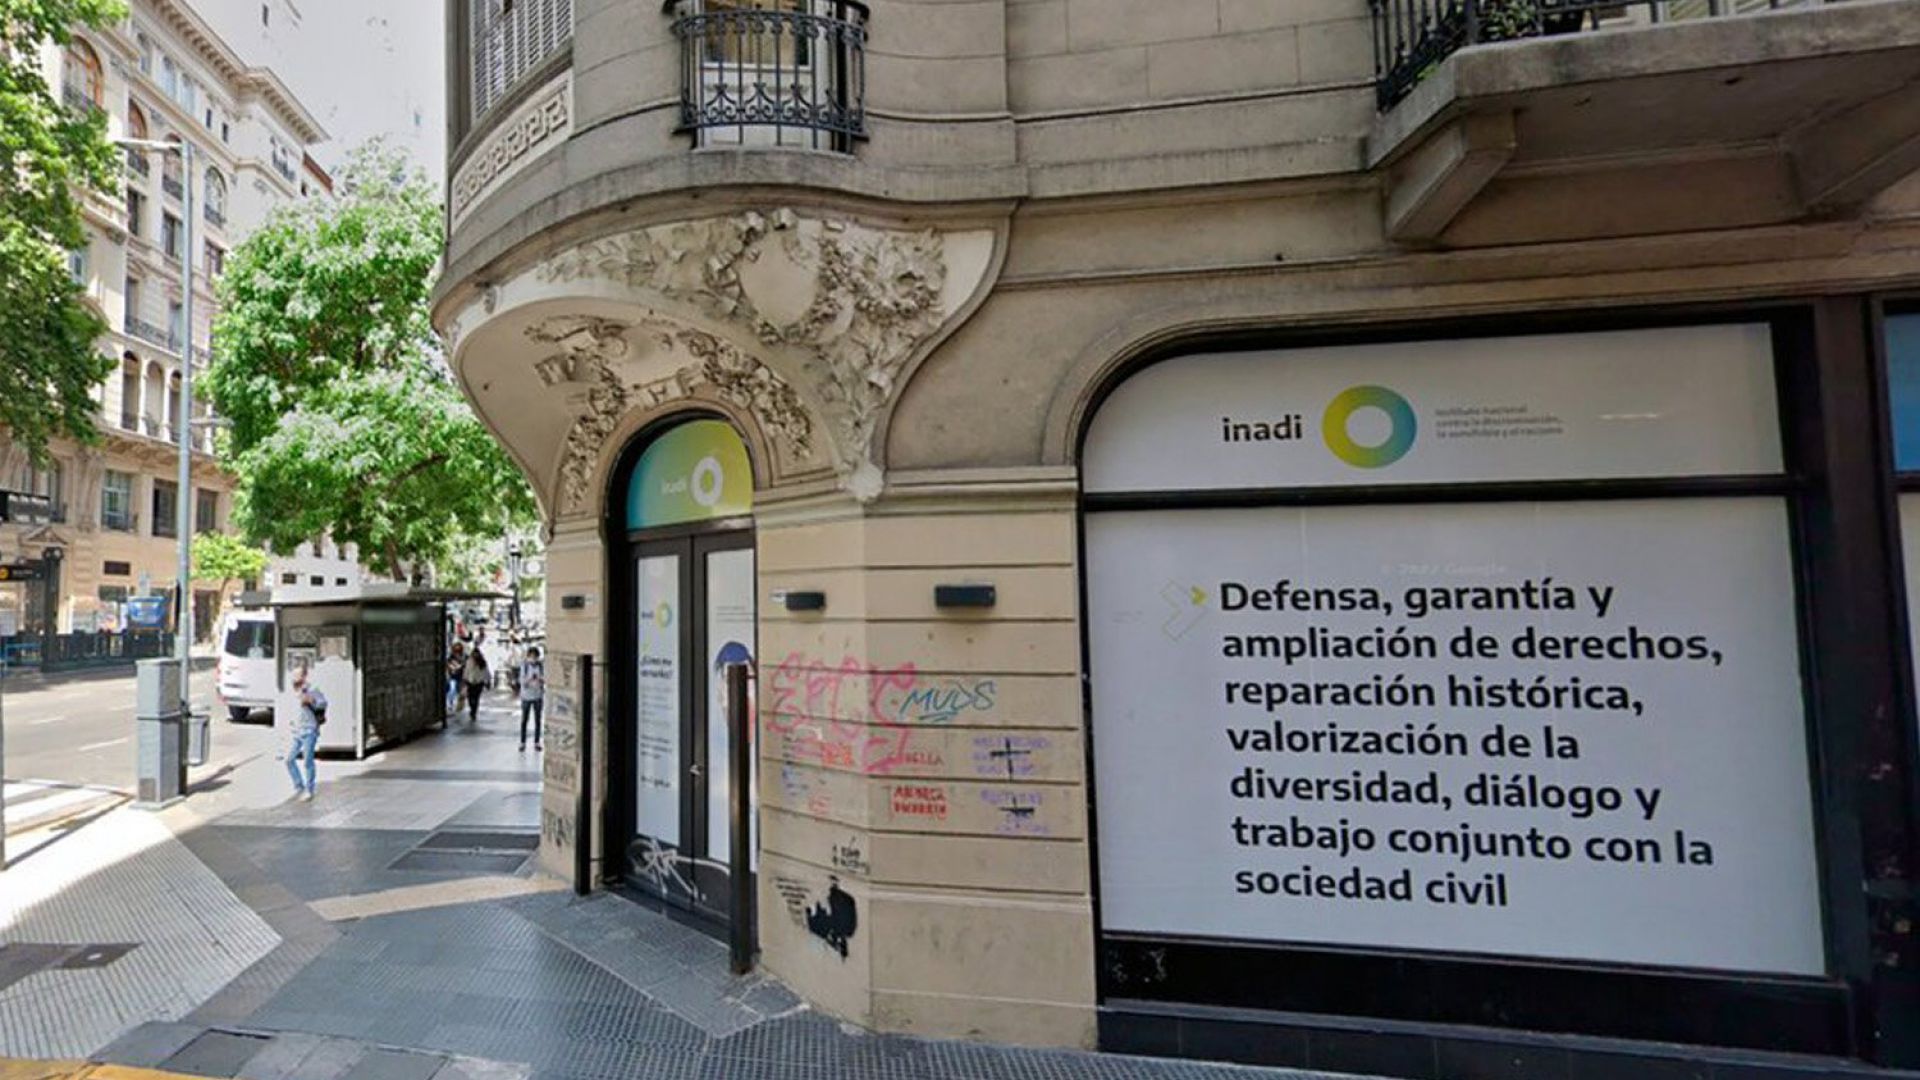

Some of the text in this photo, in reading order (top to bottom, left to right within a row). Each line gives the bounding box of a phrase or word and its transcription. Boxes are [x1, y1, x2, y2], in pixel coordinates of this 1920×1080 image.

[1222, 414, 1303, 442] inadi
[1220, 577, 1614, 619] Defensa, garantía y
[1222, 625, 1723, 667] ampliación de derechos,
[1225, 674, 1644, 717] reparación histórica,
[1226, 721, 1580, 760] valorización de la
[1230, 767, 1661, 821] diversidad, diálogo y
[1231, 816, 1714, 866] trabajo conjunto con la
[1235, 865, 1508, 907] sociedad civil
